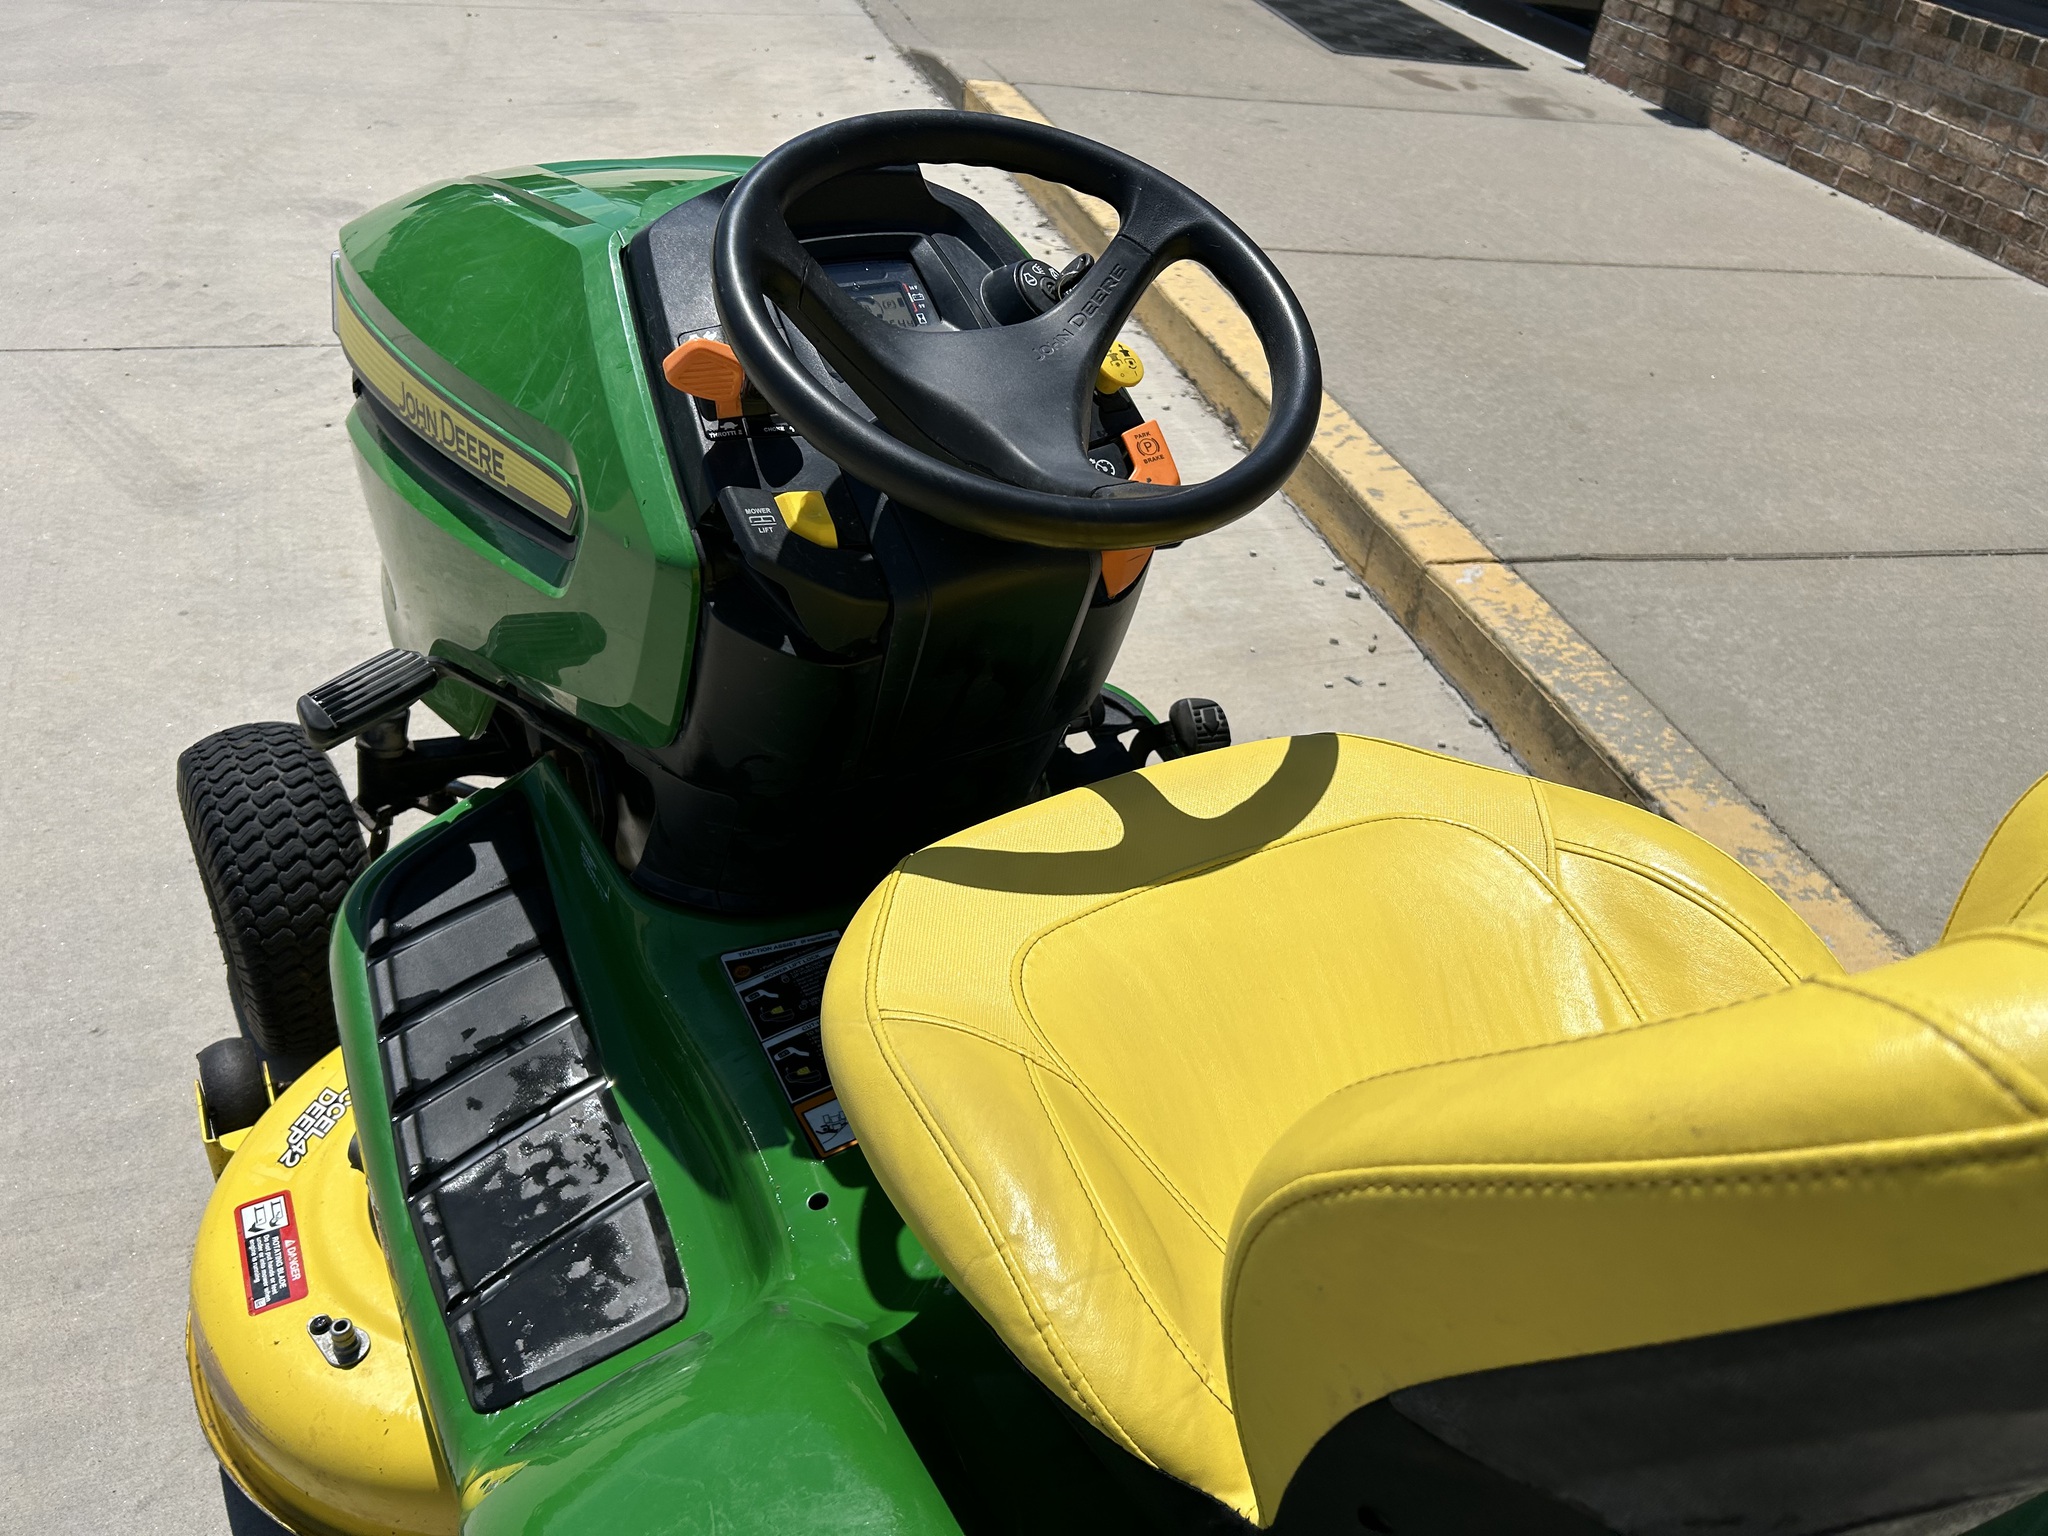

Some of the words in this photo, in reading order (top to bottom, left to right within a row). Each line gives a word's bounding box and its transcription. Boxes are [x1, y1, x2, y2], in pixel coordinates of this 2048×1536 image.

[1032, 328, 1076, 362] JOHN
[1068, 263, 1127, 329] DEERE
[399, 381, 438, 442] JOHN
[440, 408, 506, 482] DEERE
[1143, 454, 1164, 464] BRAKE
[738, 947, 772, 957] TRACTION
[774, 941, 797, 950] ASSIST
[763, 967, 788, 979] MOWER
[803, 954, 820, 962] LOCK
[302, 1088, 352, 1139] CCEL
[256, 1236, 264, 1252] under
[262, 1234, 270, 1243] Do
[247, 1239, 257, 1257] engine
[264, 1251, 272, 1261] put
[271, 1235, 285, 1267] ROTATING
[267, 1260, 276, 1278] hands
[285, 1246, 302, 1282] DANGER
[261, 1269, 269, 1287] mower
[276, 1267, 288, 1289] BLADE
[263, 1286, 272, 1303] when
[270, 1283, 278, 1295] feet
